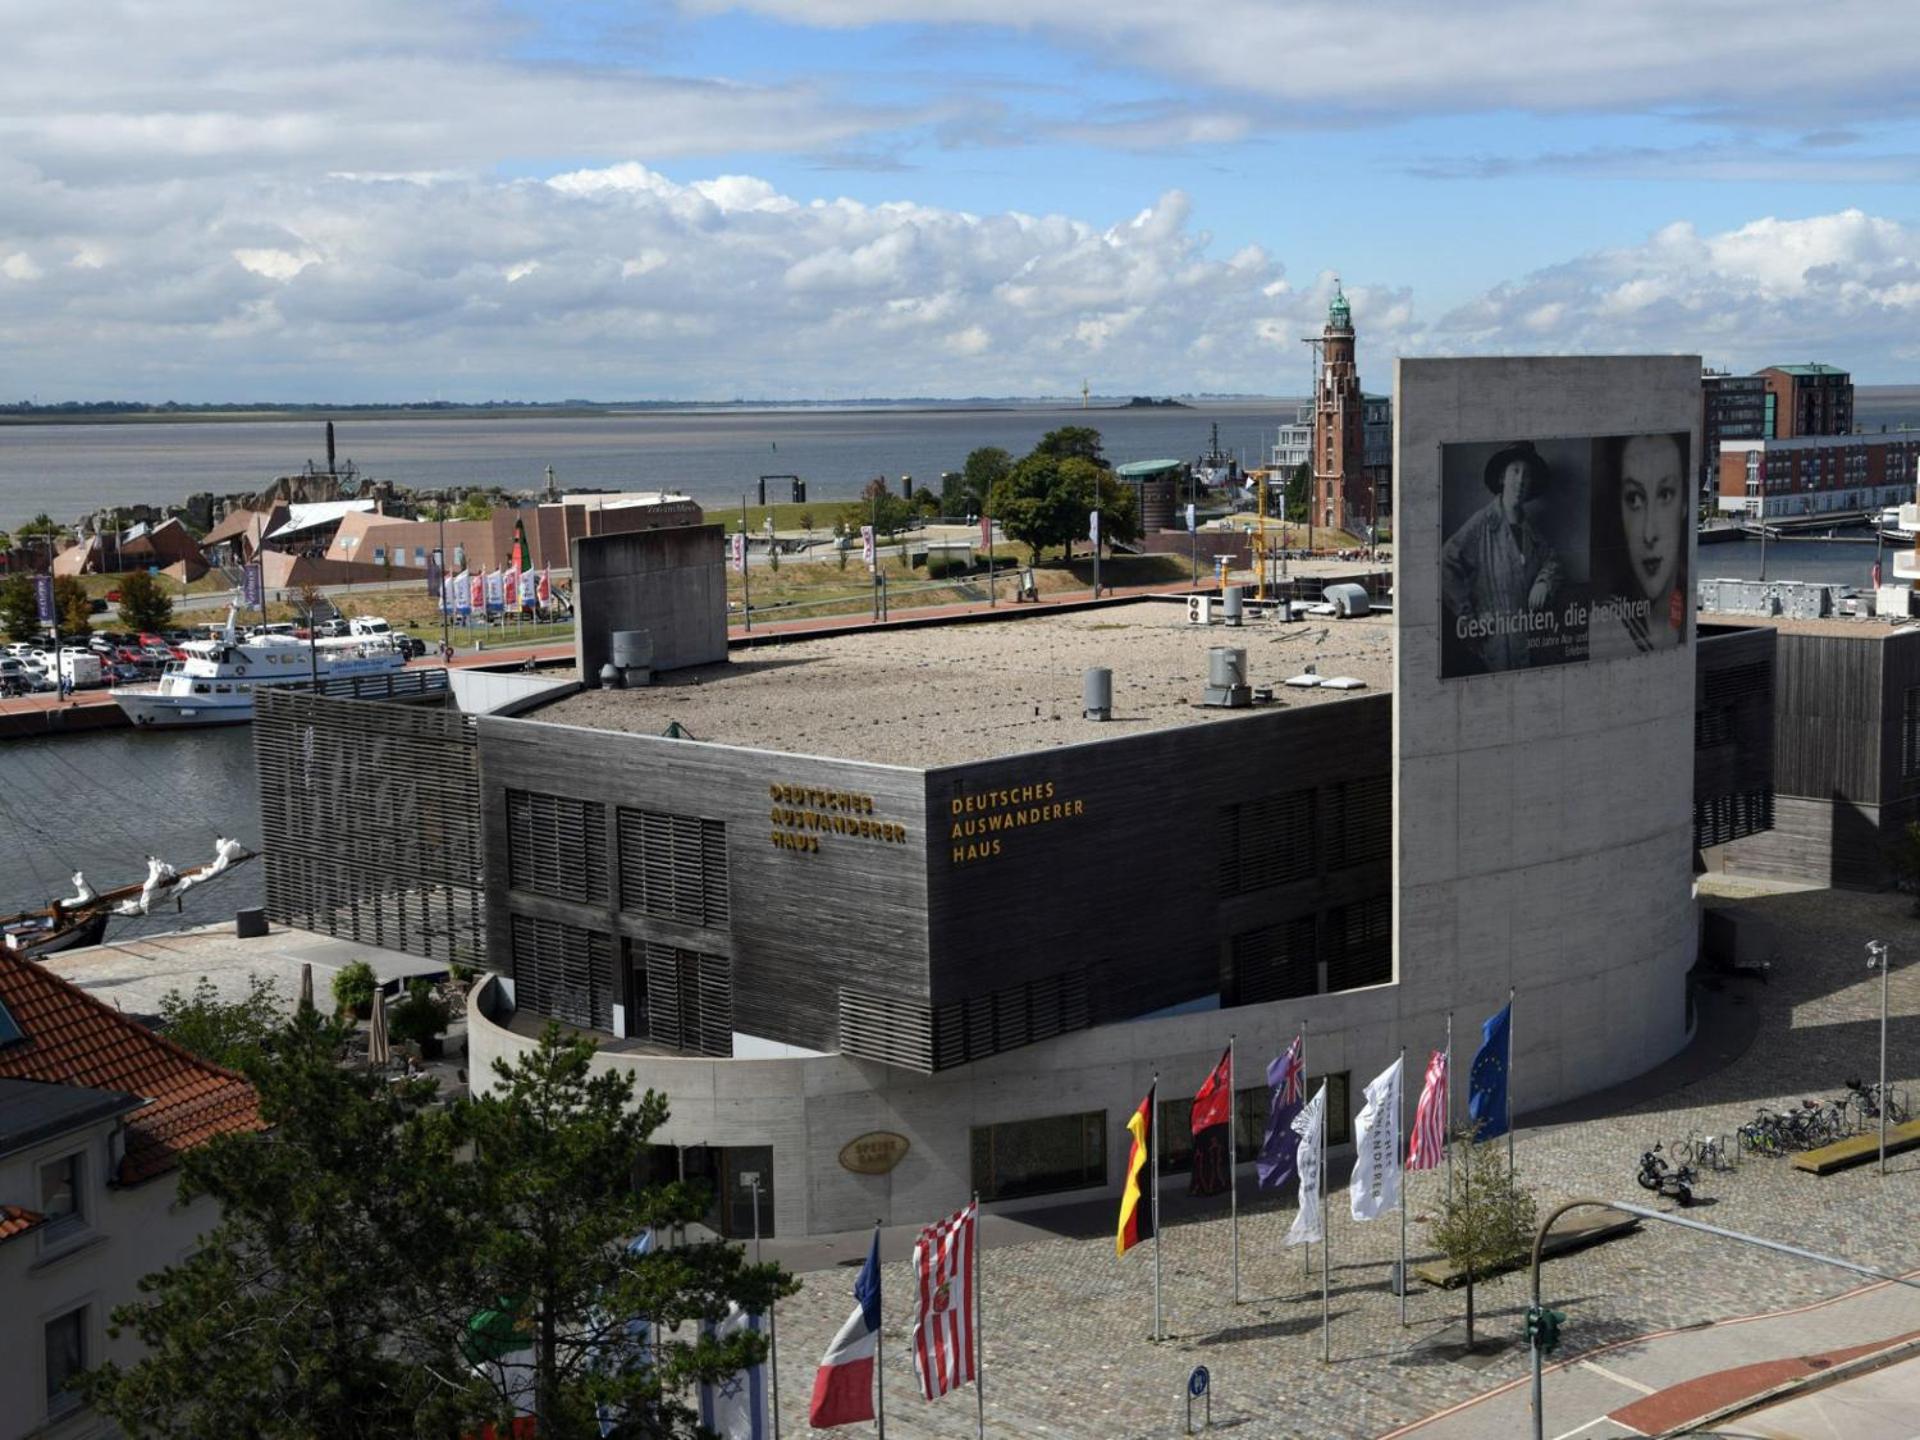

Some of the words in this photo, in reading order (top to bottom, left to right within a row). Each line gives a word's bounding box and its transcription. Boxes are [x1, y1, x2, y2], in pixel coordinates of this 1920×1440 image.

[1456, 607, 1560, 639] Geschichten,
[1564, 602, 1588, 627] die
[1590, 595, 1652, 623] berühren
[769, 783, 873, 815] DEUTSCHES
[952, 782, 1054, 814] DEUTSCHES
[770, 805, 906, 844] AUSWANDERER
[951, 799, 1084, 838] AUSWANDERER
[771, 829, 819, 854] HAUS
[953, 839, 1001, 862] HAUS
